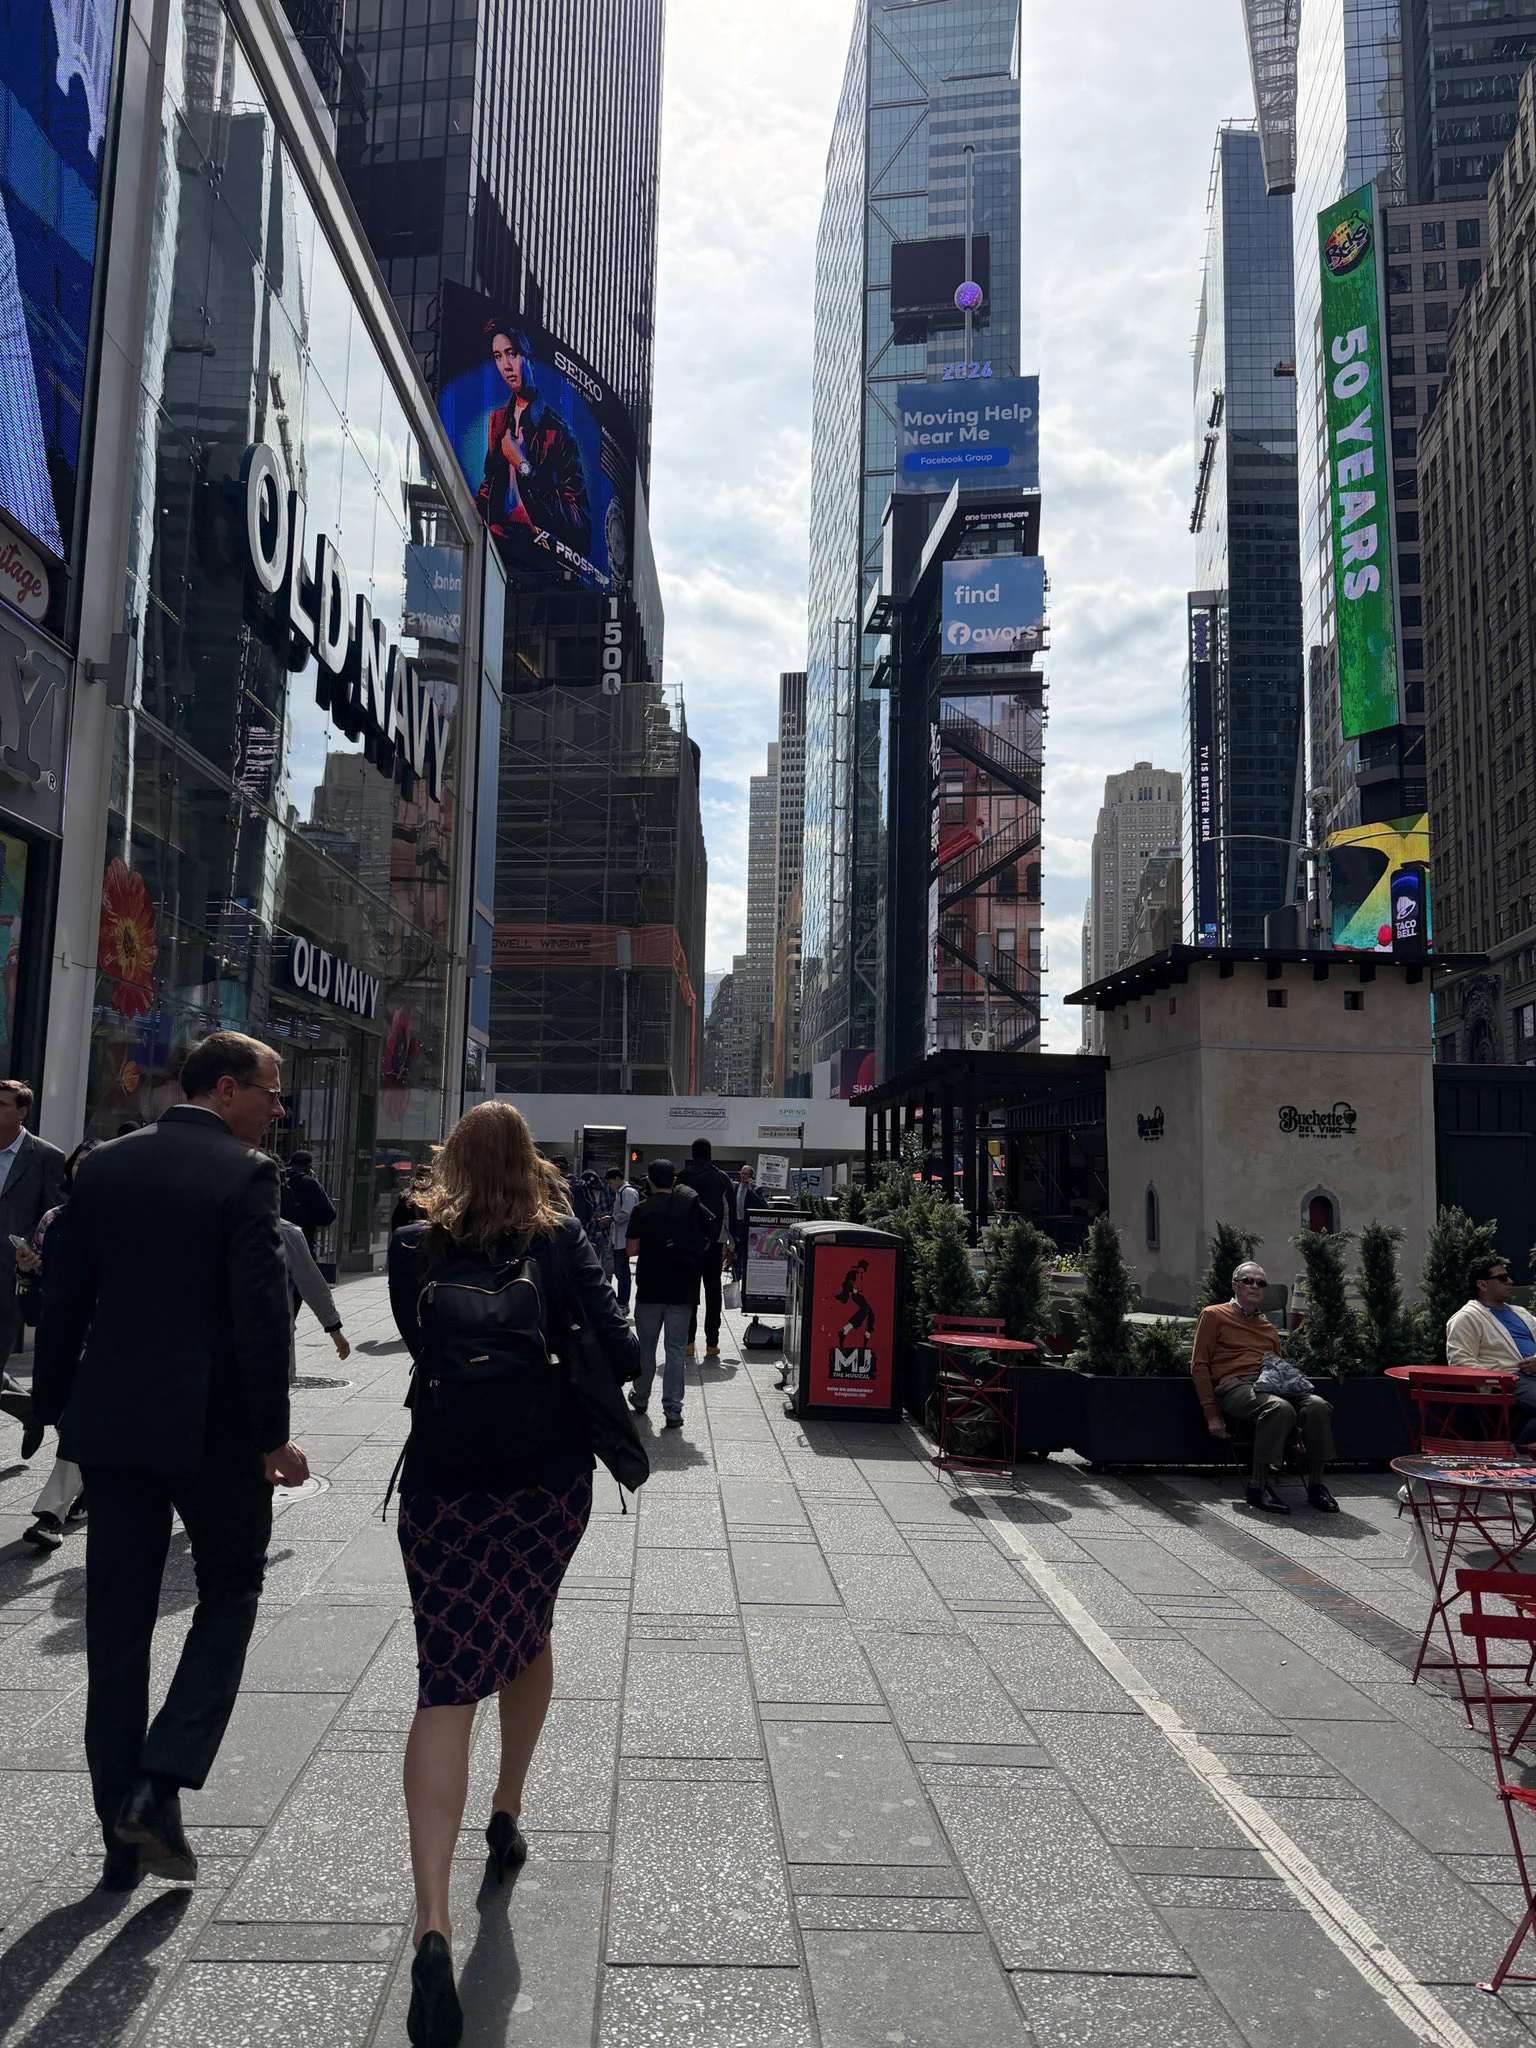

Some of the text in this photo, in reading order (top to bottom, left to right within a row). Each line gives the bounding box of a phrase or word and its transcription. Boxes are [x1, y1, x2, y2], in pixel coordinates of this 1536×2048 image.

[554, 351, 602, 402] SEIKO
[903, 403, 1033, 427] Moving Help
[903, 426, 990, 446] Near Me
[920, 453, 993, 465] Facebook Group
[1331, 325, 1380, 600] 50 YEARS
[1002, 511, 1029, 521] square
[954, 583, 1000, 605] find
[242, 442, 350, 675] OLD
[354, 593, 450, 804] NAVY
[601, 597, 623, 696] 1500
[1200, 745, 1211, 842] TV IS BETTER HERE
[1395, 920, 1417, 939] TACO BELL
[540, 939, 591, 950] WINGATE
[294, 936, 380, 1019] OLD NAVY
[852, 1084, 878, 1094] SHA
[1278, 1105, 1344, 1133] Buchette
[1298, 1125, 1341, 1134] DEL VINO
[834, 1348, 872, 1373] MJ
